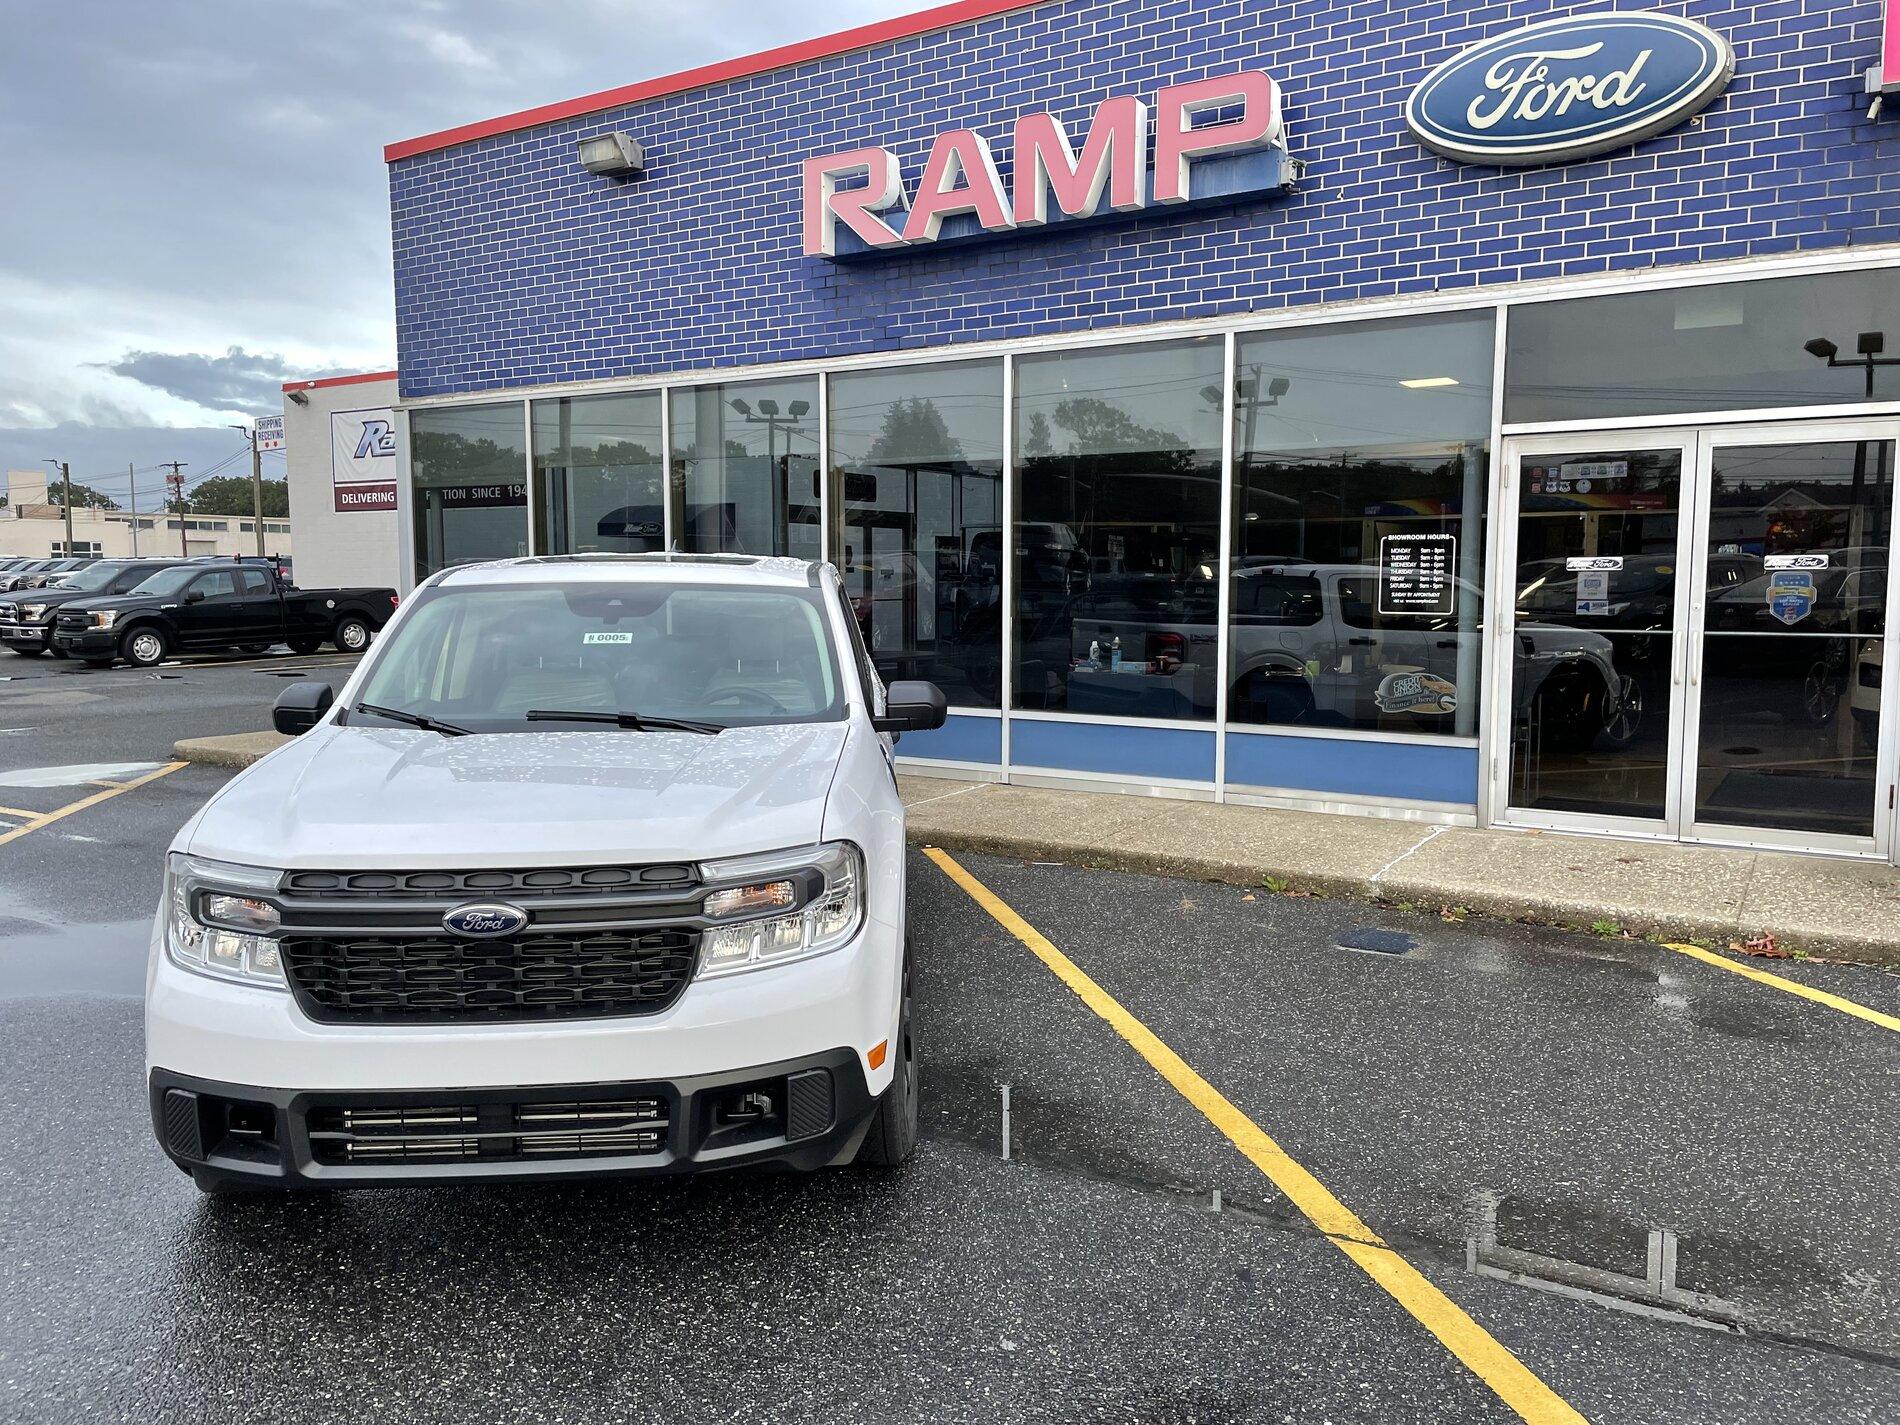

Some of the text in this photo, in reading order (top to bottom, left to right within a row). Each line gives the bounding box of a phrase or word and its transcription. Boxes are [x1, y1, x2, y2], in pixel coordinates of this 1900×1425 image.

[1466, 41, 1653, 130] Ford
[803, 70, 1282, 257] RAMP
[258, 418, 283, 430] SHIPPING
[258, 429, 284, 441] RECEIVING
[342, 491, 395, 504] DELIVERING
[471, 487, 501, 499] SINCE
[1593, 559, 1614, 568] Ford
[1795, 557, 1818, 566] Ford
[1393, 676, 1420, 687] CREDIT
[1393, 683, 1421, 694] UNION
[1385, 701, 1410, 709] Finance
[462, 912, 506, 930] Ford
